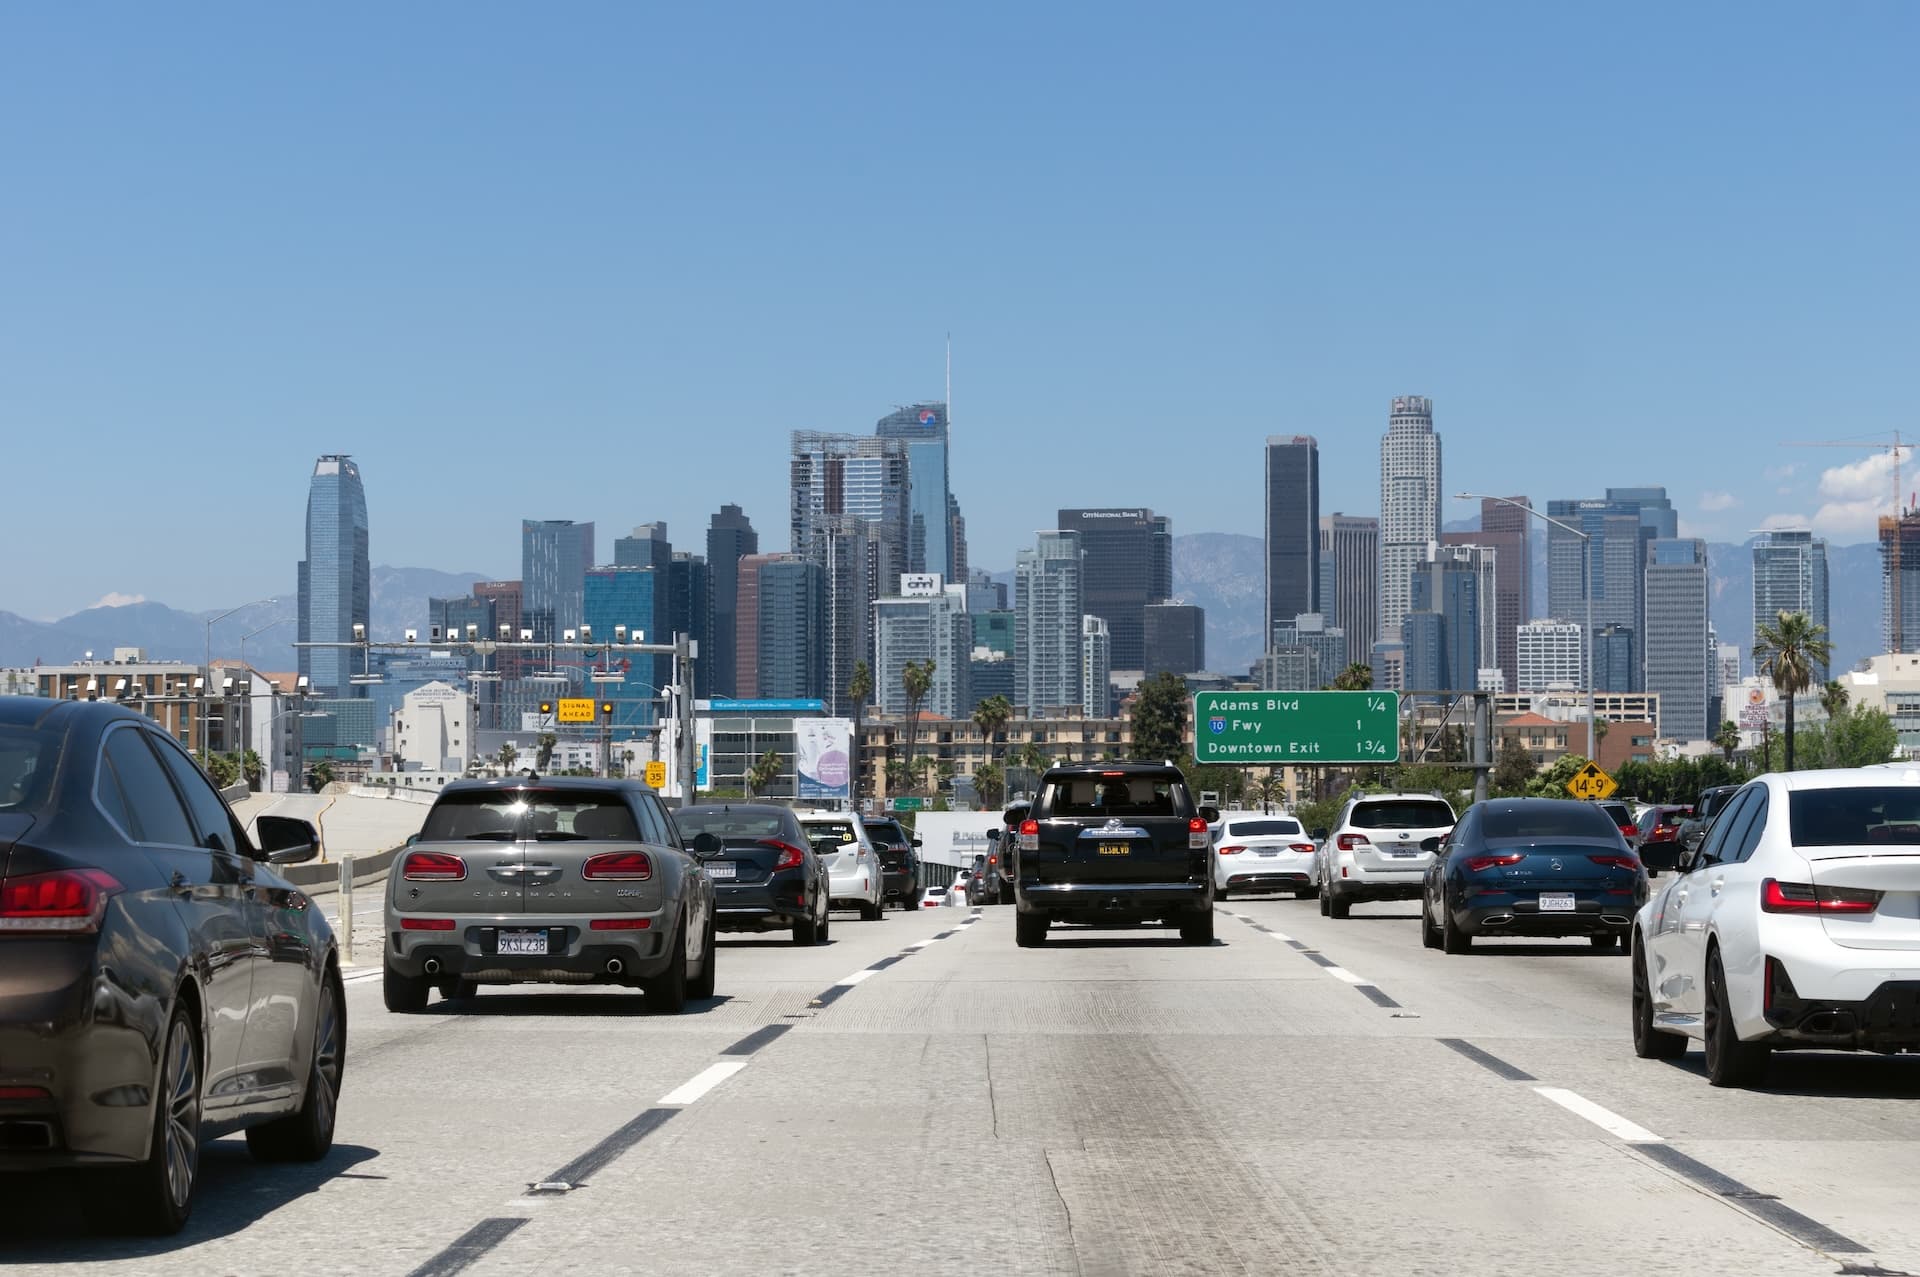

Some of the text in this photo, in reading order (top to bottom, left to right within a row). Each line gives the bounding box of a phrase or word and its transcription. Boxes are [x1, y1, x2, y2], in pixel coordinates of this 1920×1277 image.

[1208, 699, 1259, 711] Adams
[1266, 699, 1299, 711] Blvd
[1212, 719, 1362, 734] 10 Fwy 1
[1208, 742, 1282, 754] Downtown
[1289, 742, 1320, 754] Exit
[649, 772, 662, 782] 35
